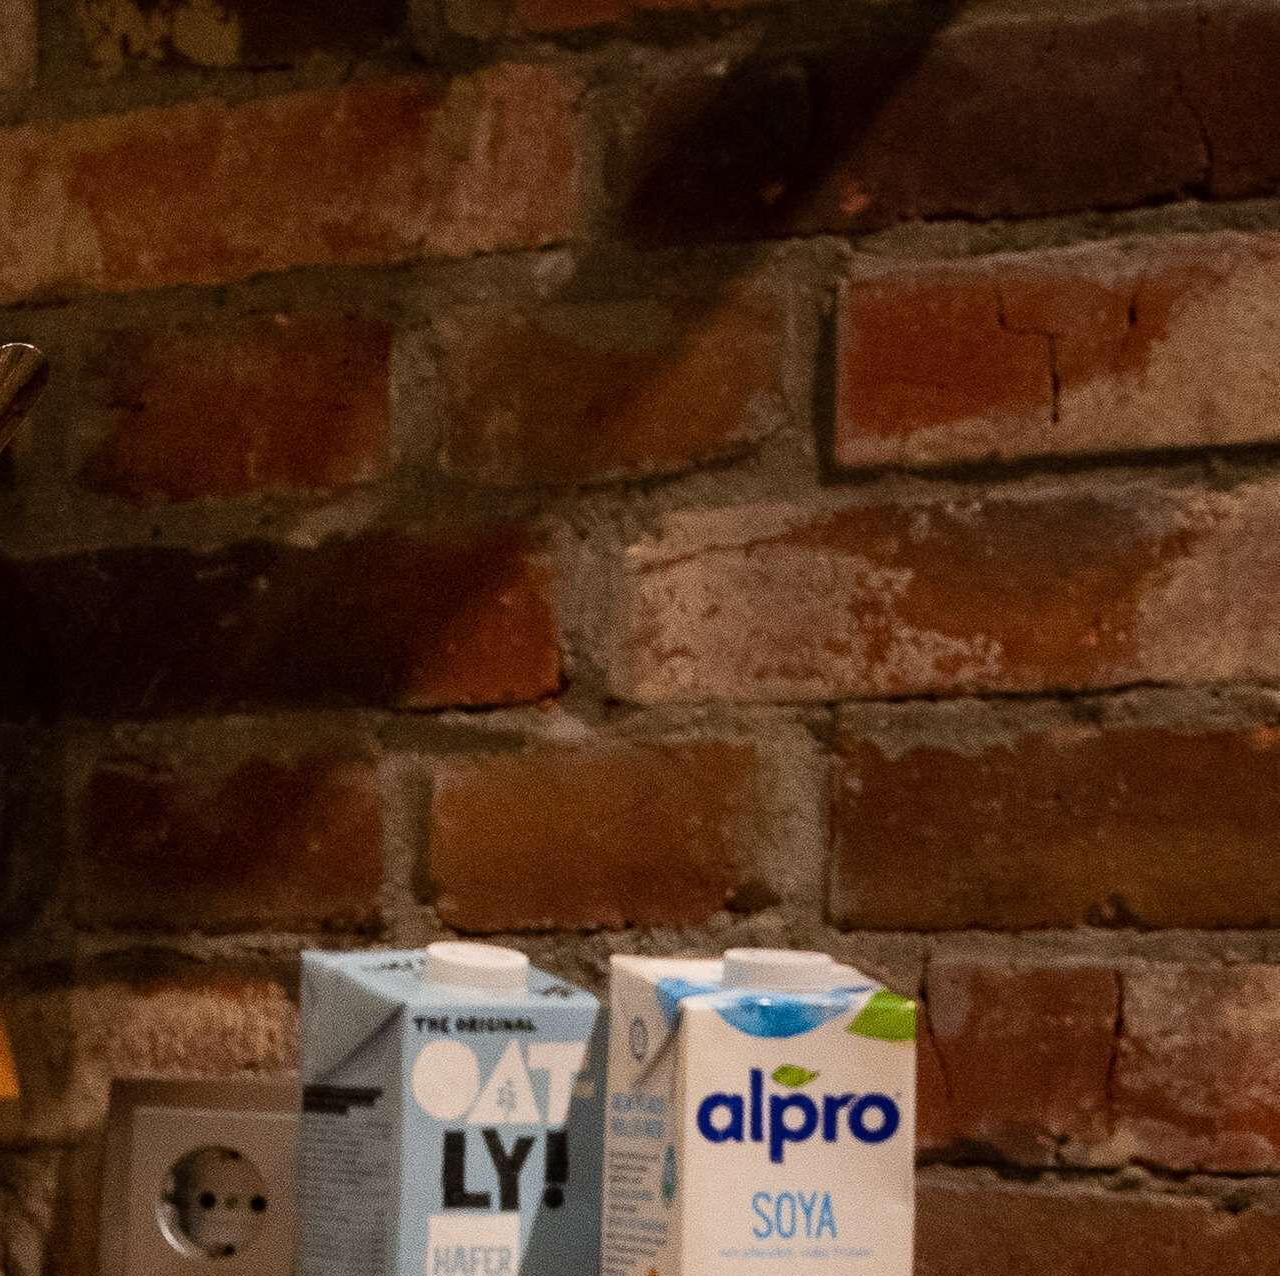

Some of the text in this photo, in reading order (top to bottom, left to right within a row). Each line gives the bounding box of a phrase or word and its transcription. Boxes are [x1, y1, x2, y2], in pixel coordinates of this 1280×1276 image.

[412, 1040, 590, 1125] OAT
[696, 1066, 902, 1163] alpro
[443, 1128, 569, 1211] LY!
[751, 1190, 838, 1239] SOYA
